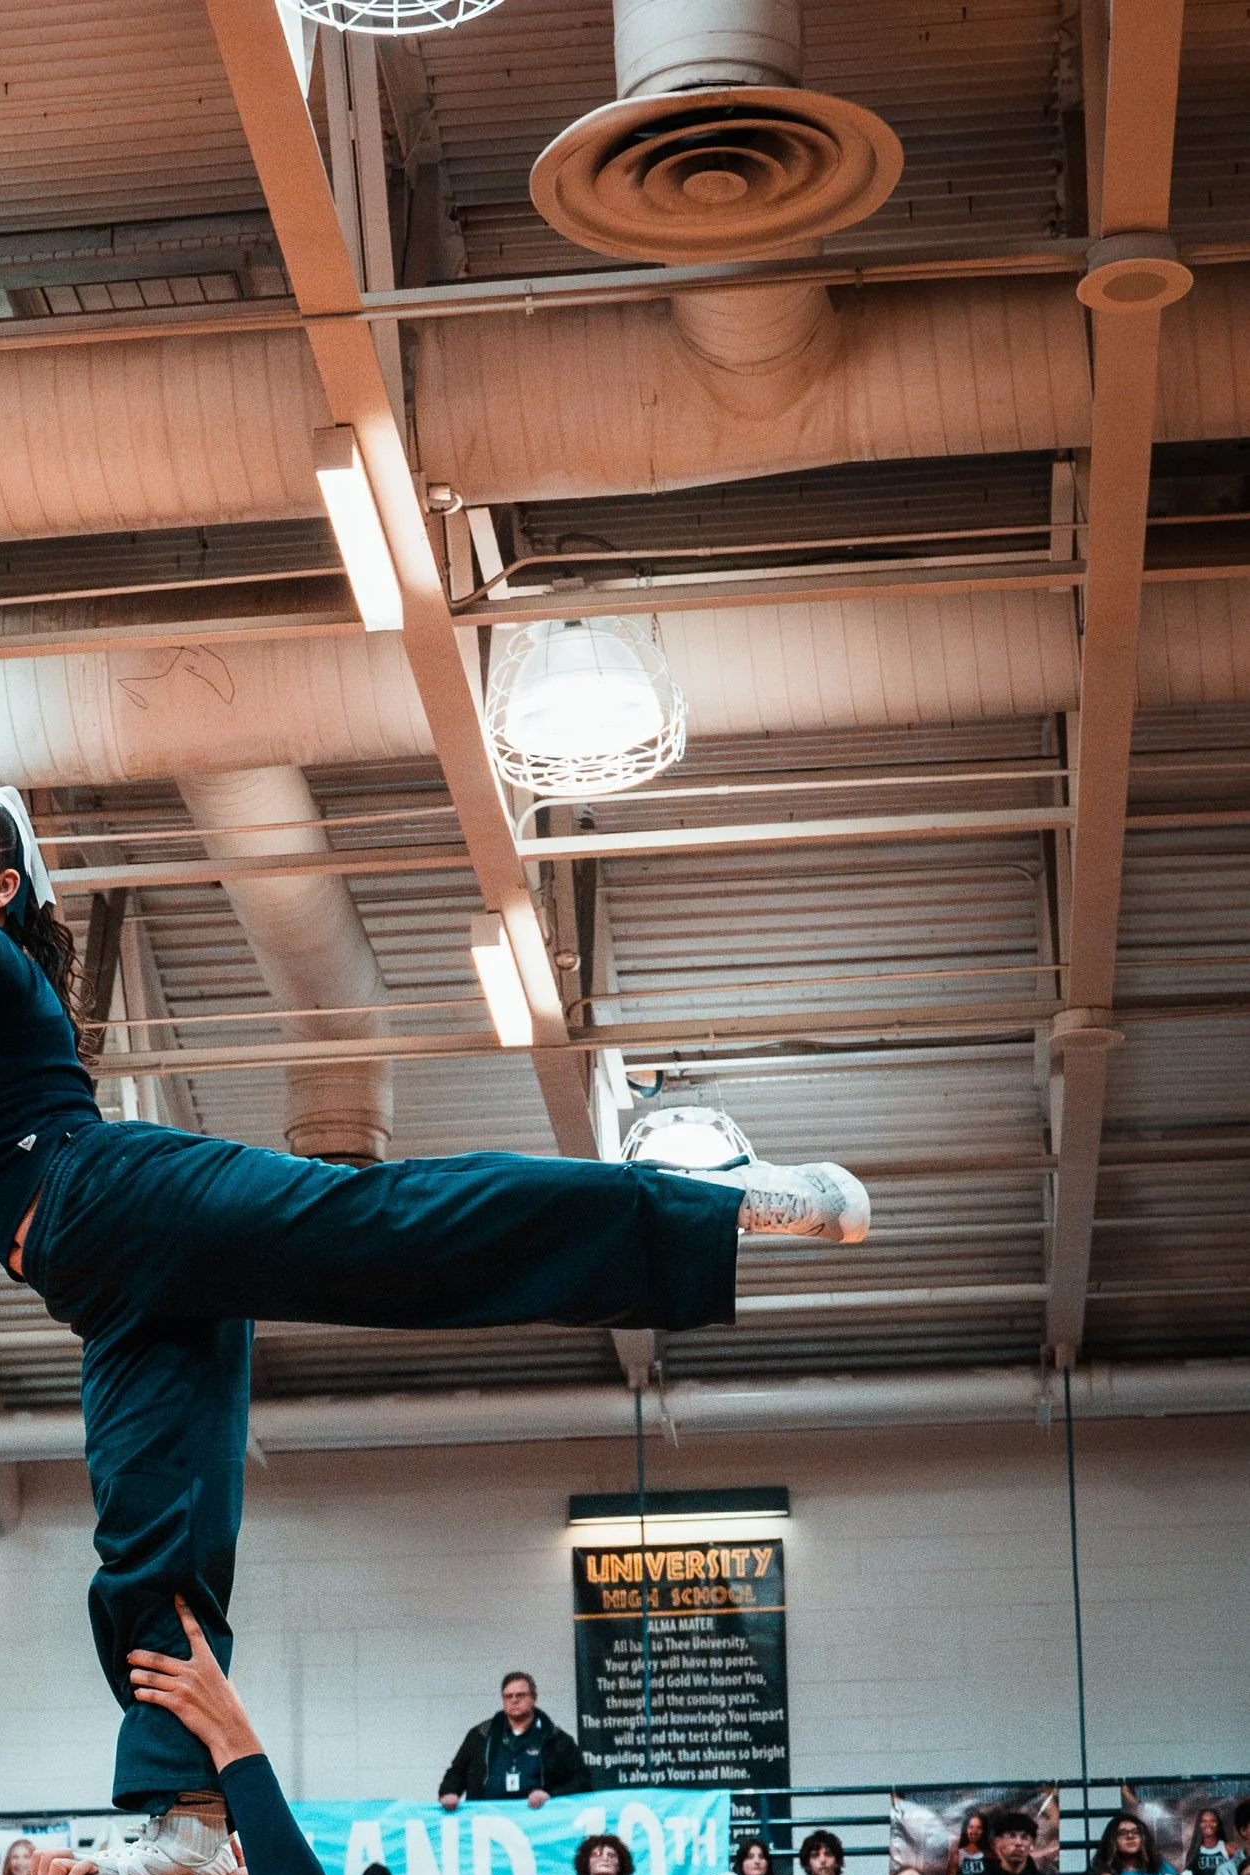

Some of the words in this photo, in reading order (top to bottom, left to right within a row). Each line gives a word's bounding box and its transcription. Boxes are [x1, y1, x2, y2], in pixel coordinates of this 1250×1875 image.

[586, 1548, 774, 1583] UNIVERSITY
[671, 1584, 756, 1606] SCHOOL
[678, 1616, 715, 1632] MATER
[665, 1637, 690, 1651] Thee
[692, 1634, 749, 1651] University,
[661, 1655, 680, 1669] will
[682, 1655, 707, 1669] have
[709, 1656, 723, 1668] no
[596, 1676, 617, 1692] The
[618, 1676, 643, 1691] Blue
[649, 1674, 665, 1689] nd
[666, 1672, 692, 1688] Gold
[711, 1671, 743, 1687] honor
[744, 1671, 767, 1686] You,
[651, 1692, 664, 1707] all
[666, 1692, 684, 1706] the
[686, 1691, 726, 1708] coming
[727, 1691, 759, 1706] years.
[581, 1714, 601, 1729] The
[602, 1712, 646, 1731] strength
[670, 1711, 727, 1728] knowledge
[728, 1709, 747, 1723] You
[749, 1708, 785, 1724] impart
[613, 1731, 635, 1746] will
[636, 1729, 666, 1745] stnd
[668, 1729, 687, 1744] the
[688, 1729, 709, 1743] test
[711, 1728, 723, 1742] of
[724, 1728, 753, 1743] time,
[582, 1750, 602, 1766] The
[603, 1750, 646, 1769] guiding
[650, 1749, 676, 1766] ight,
[677, 1747, 700, 1762] that
[702, 1746, 737, 1762] shines
[738, 1748, 750, 1761] so
[751, 1744, 786, 1762] bright
[618, 1769, 628, 1784] is
[667, 1768, 696, 1782] Yours
[698, 1766, 719, 1781] and
[720, 1765, 750, 1781] Mine.
